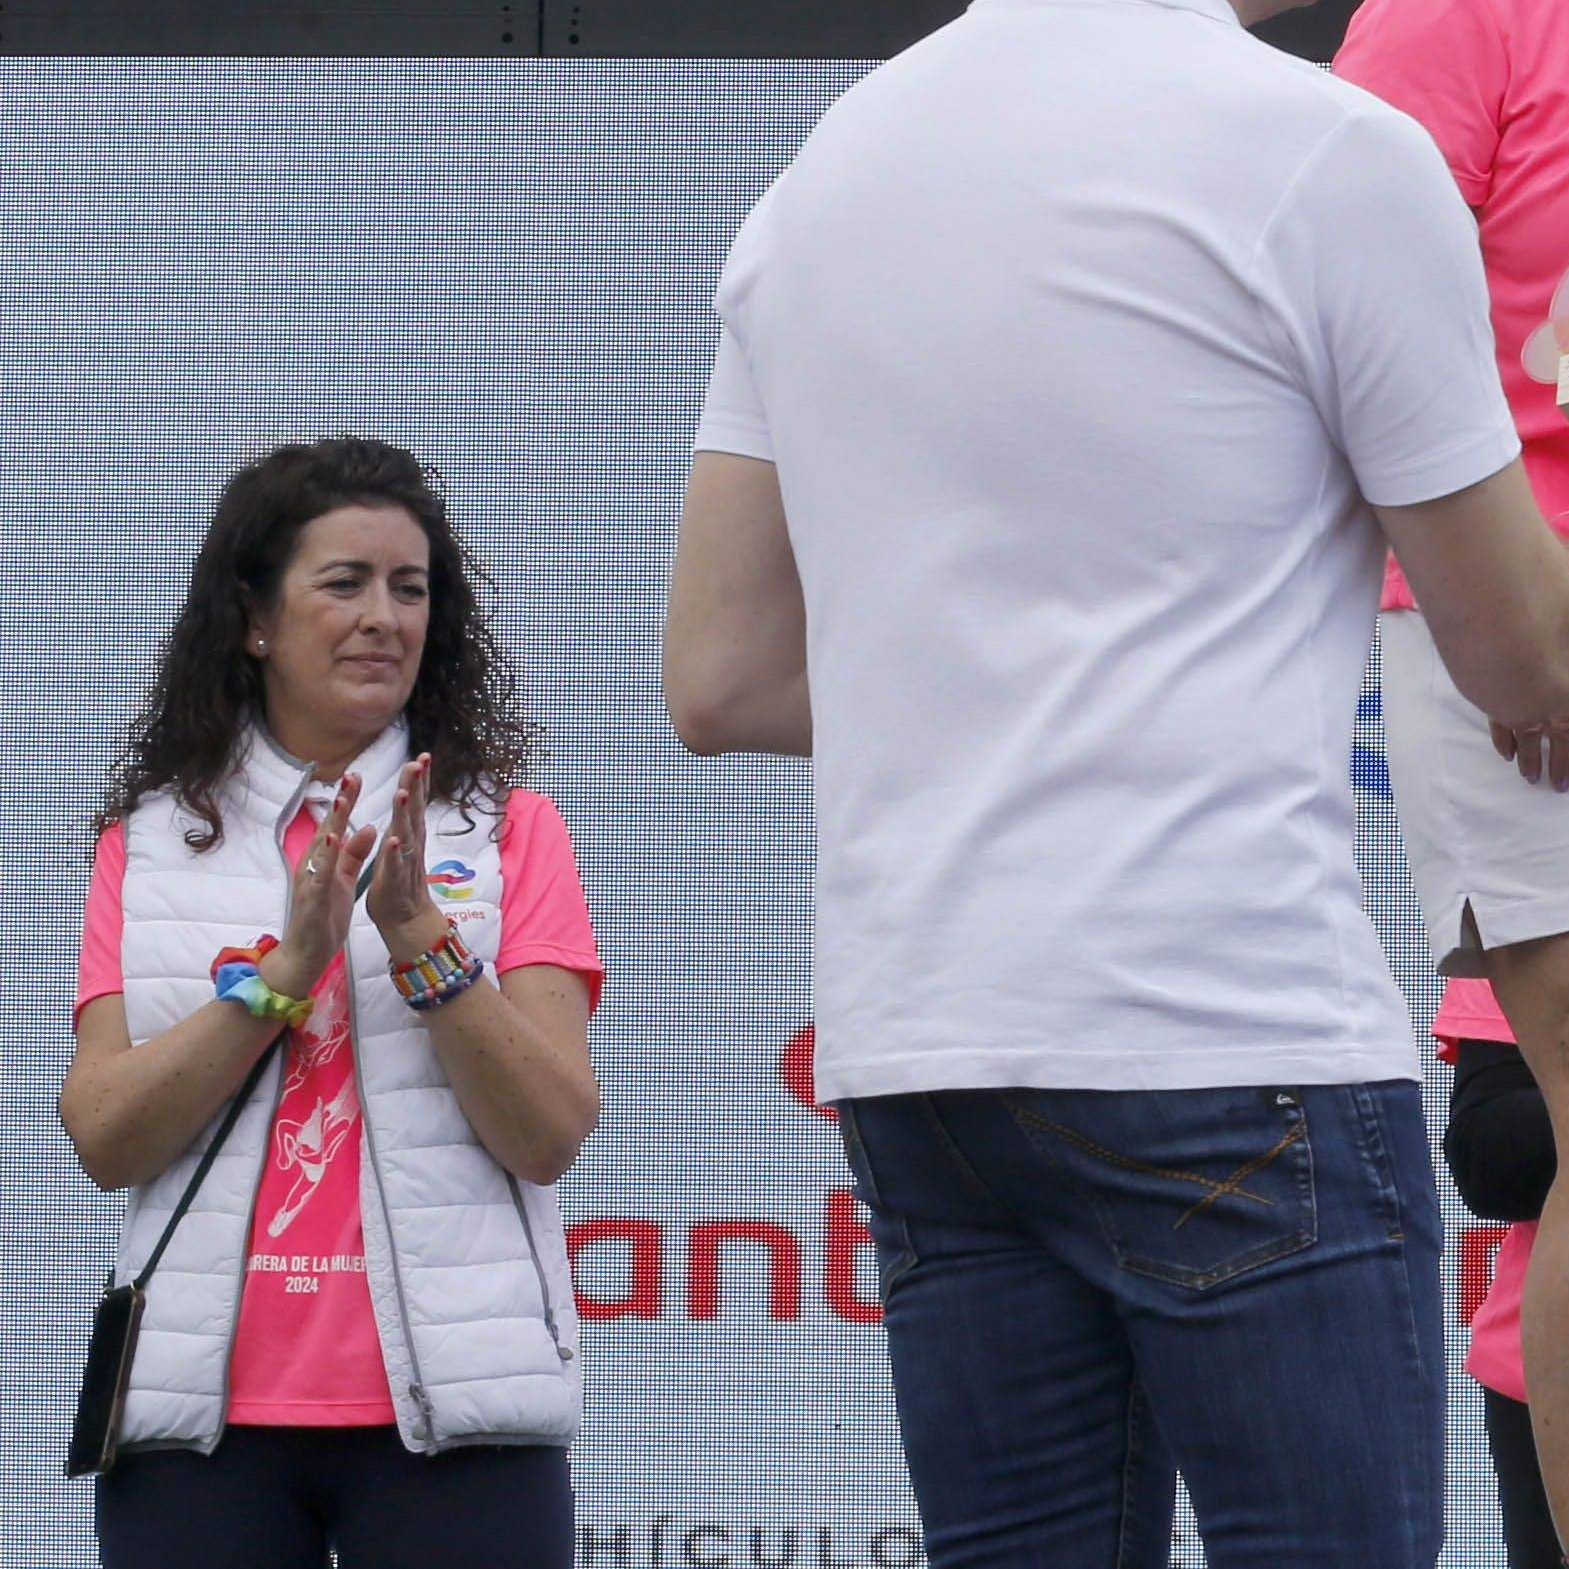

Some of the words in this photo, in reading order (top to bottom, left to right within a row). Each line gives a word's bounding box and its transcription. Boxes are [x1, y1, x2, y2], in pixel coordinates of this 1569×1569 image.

[291, 1256, 309, 1272] DE
[312, 1257, 328, 1273] LA
[285, 1276, 319, 1293] 2024
